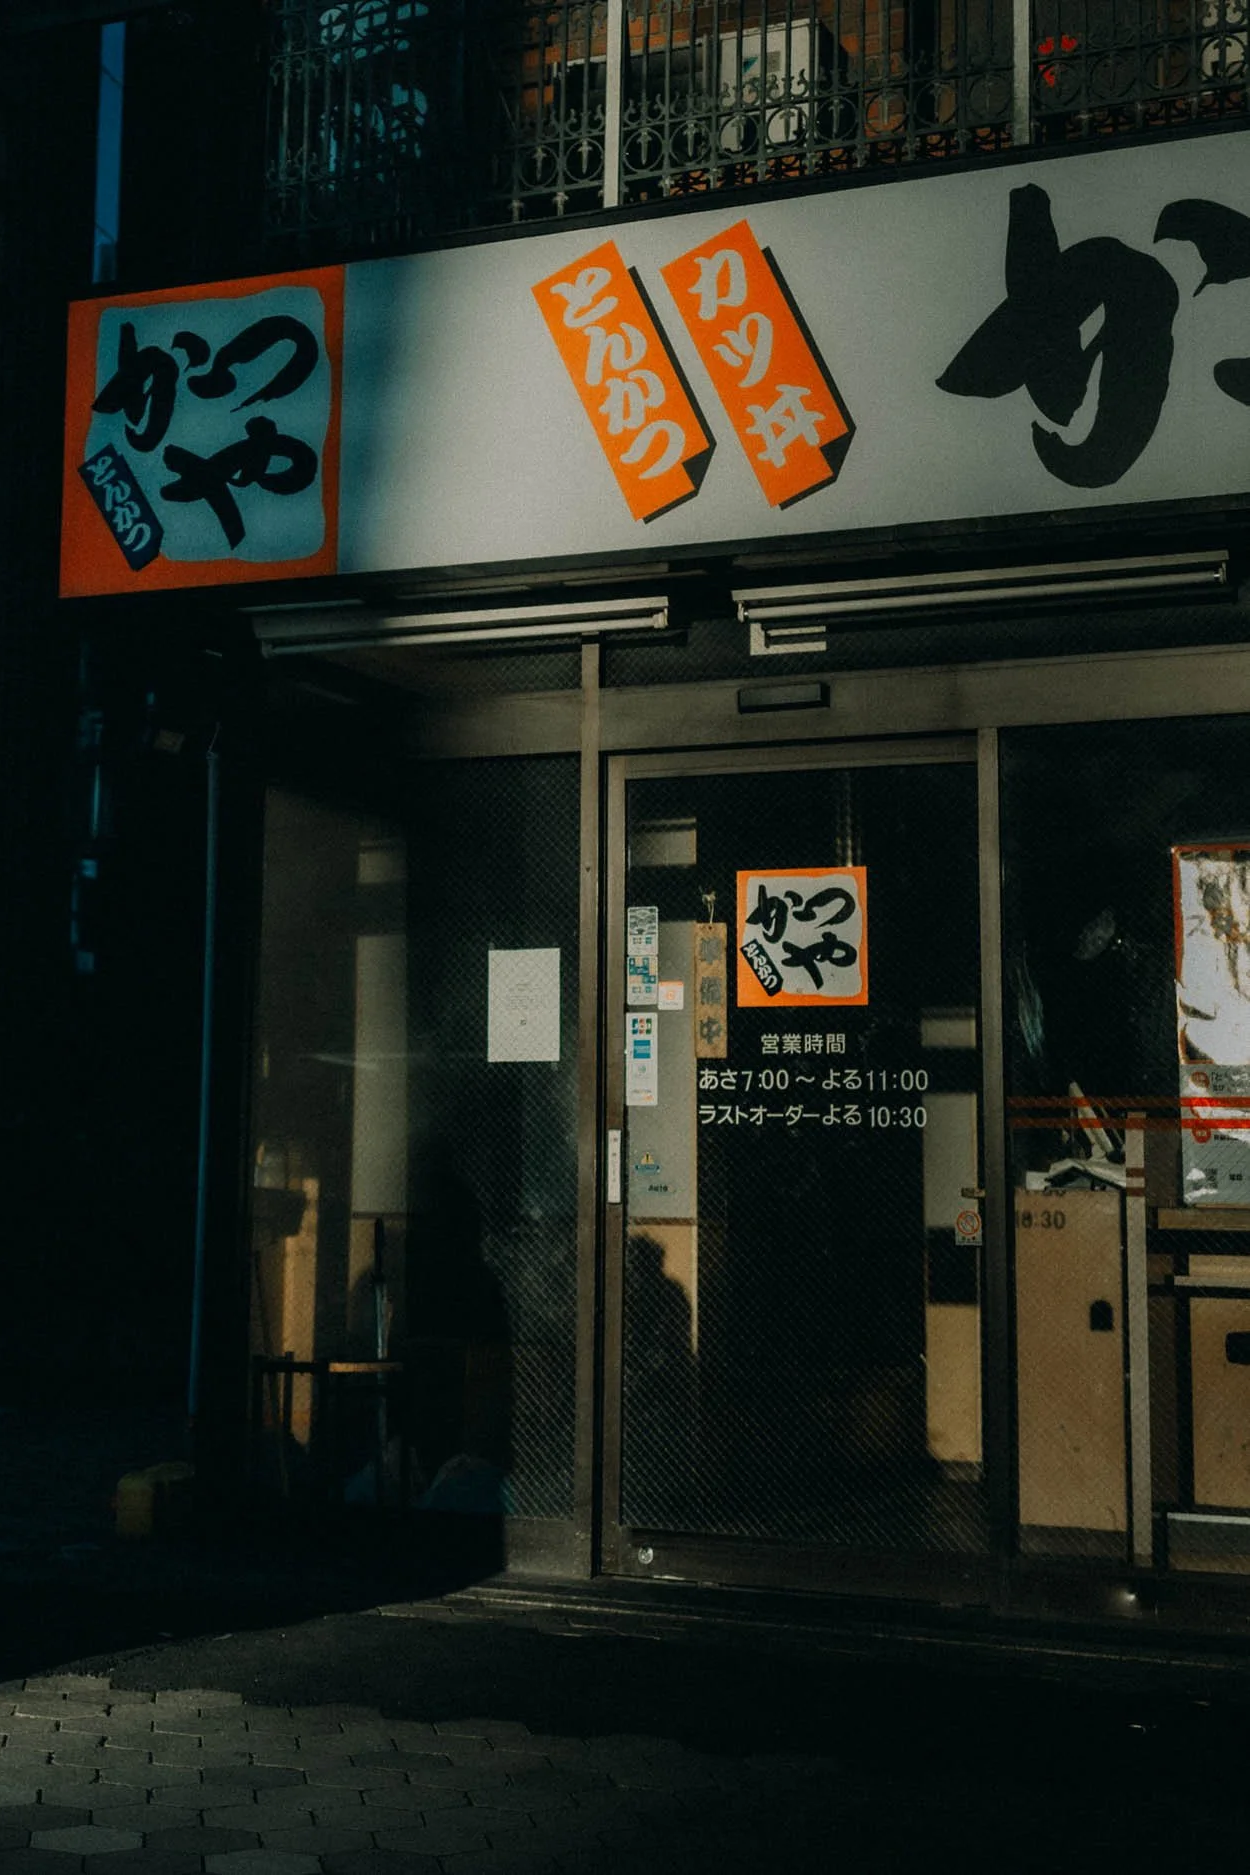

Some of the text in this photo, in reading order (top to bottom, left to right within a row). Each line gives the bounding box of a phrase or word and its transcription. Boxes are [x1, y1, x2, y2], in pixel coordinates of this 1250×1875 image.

[92, 315, 319, 453] かつ
[551, 266, 686, 480] とんかつ
[687, 249, 826, 468] カツ丼
[935, 183, 1250, 488] か
[160, 415, 319, 551] や
[745, 884, 856, 943] かつ
[781, 932, 857, 989] や
[760, 1032, 847, 1056] 営業時間
